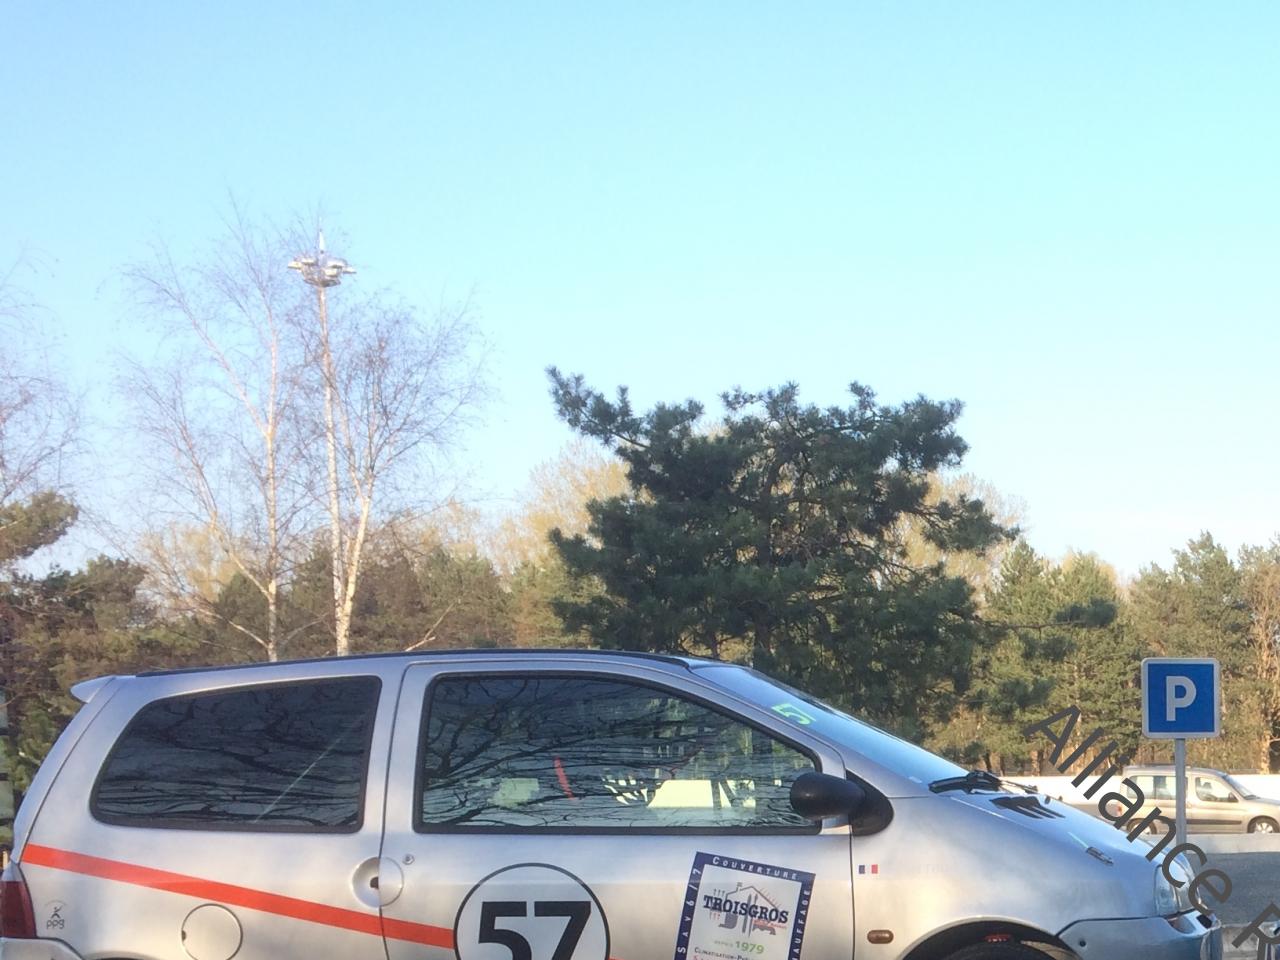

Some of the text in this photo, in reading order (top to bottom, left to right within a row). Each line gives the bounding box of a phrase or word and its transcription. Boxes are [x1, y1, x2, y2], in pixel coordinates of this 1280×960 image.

[1166, 676, 1197, 722] P
[703, 894, 789, 924] TROISGROS
[735, 940, 765, 954] 1979
